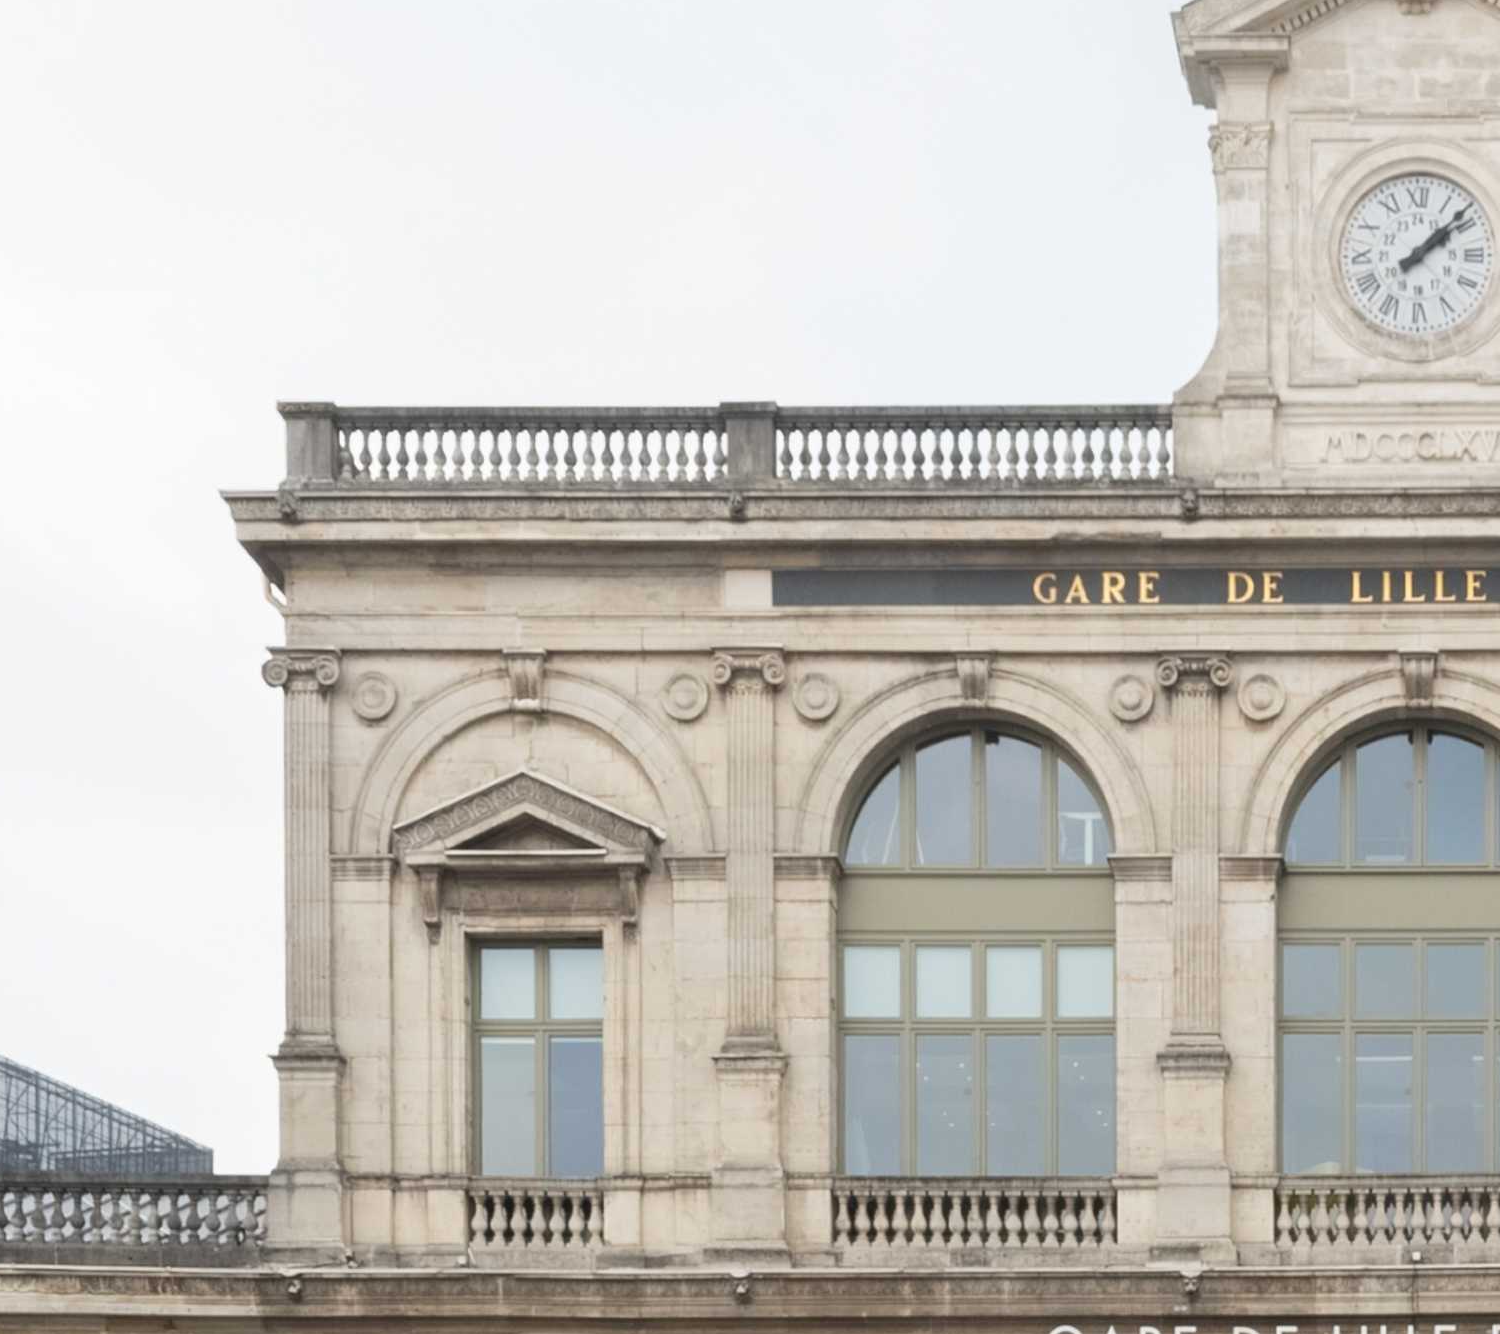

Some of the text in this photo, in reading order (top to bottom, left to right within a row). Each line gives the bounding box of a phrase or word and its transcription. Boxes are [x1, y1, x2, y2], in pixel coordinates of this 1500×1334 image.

[1378, 192, 1401, 219] XI
[1406, 186, 1430, 209] XII
[1439, 195, 1452, 215] I
[1357, 217, 1381, 238] X
[1351, 248, 1373, 265] IX
[1463, 247, 1485, 263] III
[1355, 272, 1381, 302] VIII
[1378, 293, 1400, 321] VII
[1412, 302, 1428, 324] VI
[1439, 296, 1457, 318] V
[1032, 571, 1161, 604] GARE
[1227, 571, 1284, 604] DE
[1350, 570, 1488, 603] LILLE
